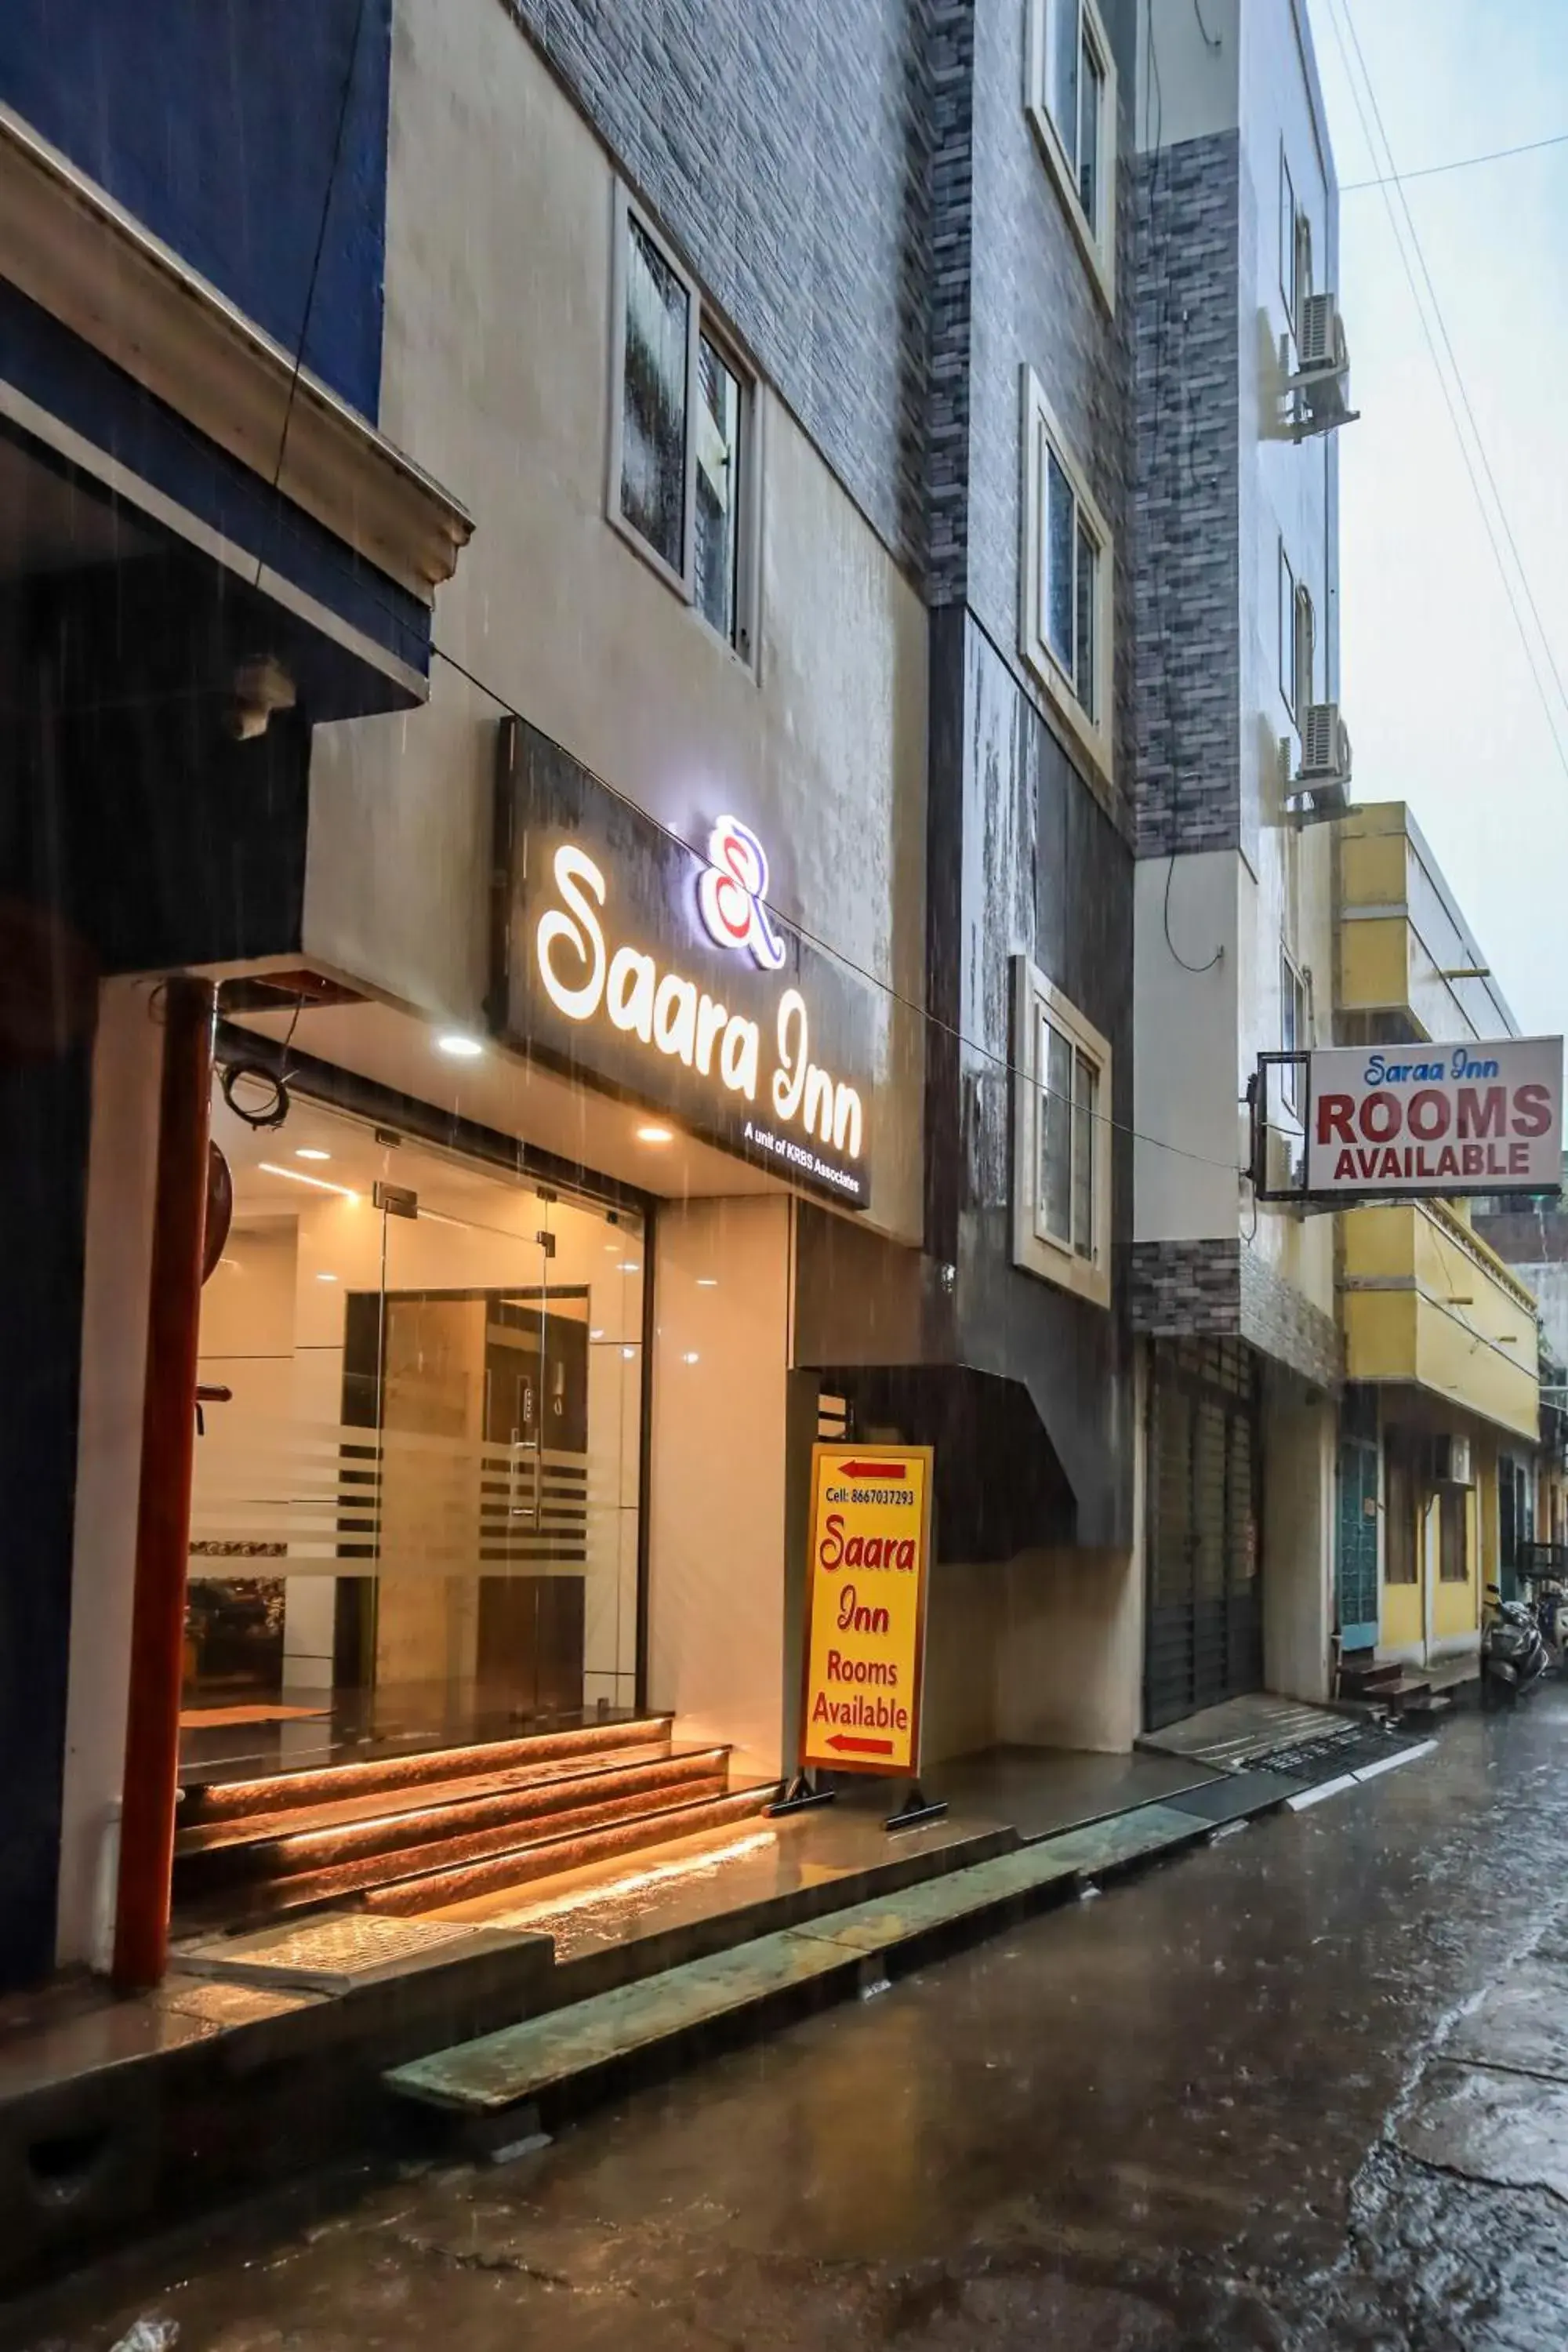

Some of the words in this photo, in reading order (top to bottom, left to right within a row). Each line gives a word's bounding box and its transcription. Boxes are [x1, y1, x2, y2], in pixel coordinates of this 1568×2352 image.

[537, 844, 760, 1100] Saara
[772, 989, 862, 1158] Inn
[1364, 1054, 1445, 1085] Saraa
[1450, 1048, 1499, 1080] Inn
[1316, 1084, 1552, 1145] ROOMS
[745, 1121, 753, 1139] A
[755, 1130, 774, 1150] unit
[775, 1139, 786, 1156] of
[786, 1142, 813, 1170] KRBS
[814, 1158, 860, 1193] Associates
[1334, 1142, 1530, 1180] AVAILABLE
[826, 1487, 849, 1503] Cell:
[851, 1488, 914, 1505] 8667037293
[819, 1514, 915, 1571] Saara
[837, 1584, 889, 1634] Inn
[827, 1650, 898, 1686] Rooms
[812, 1692, 908, 1730] Available
